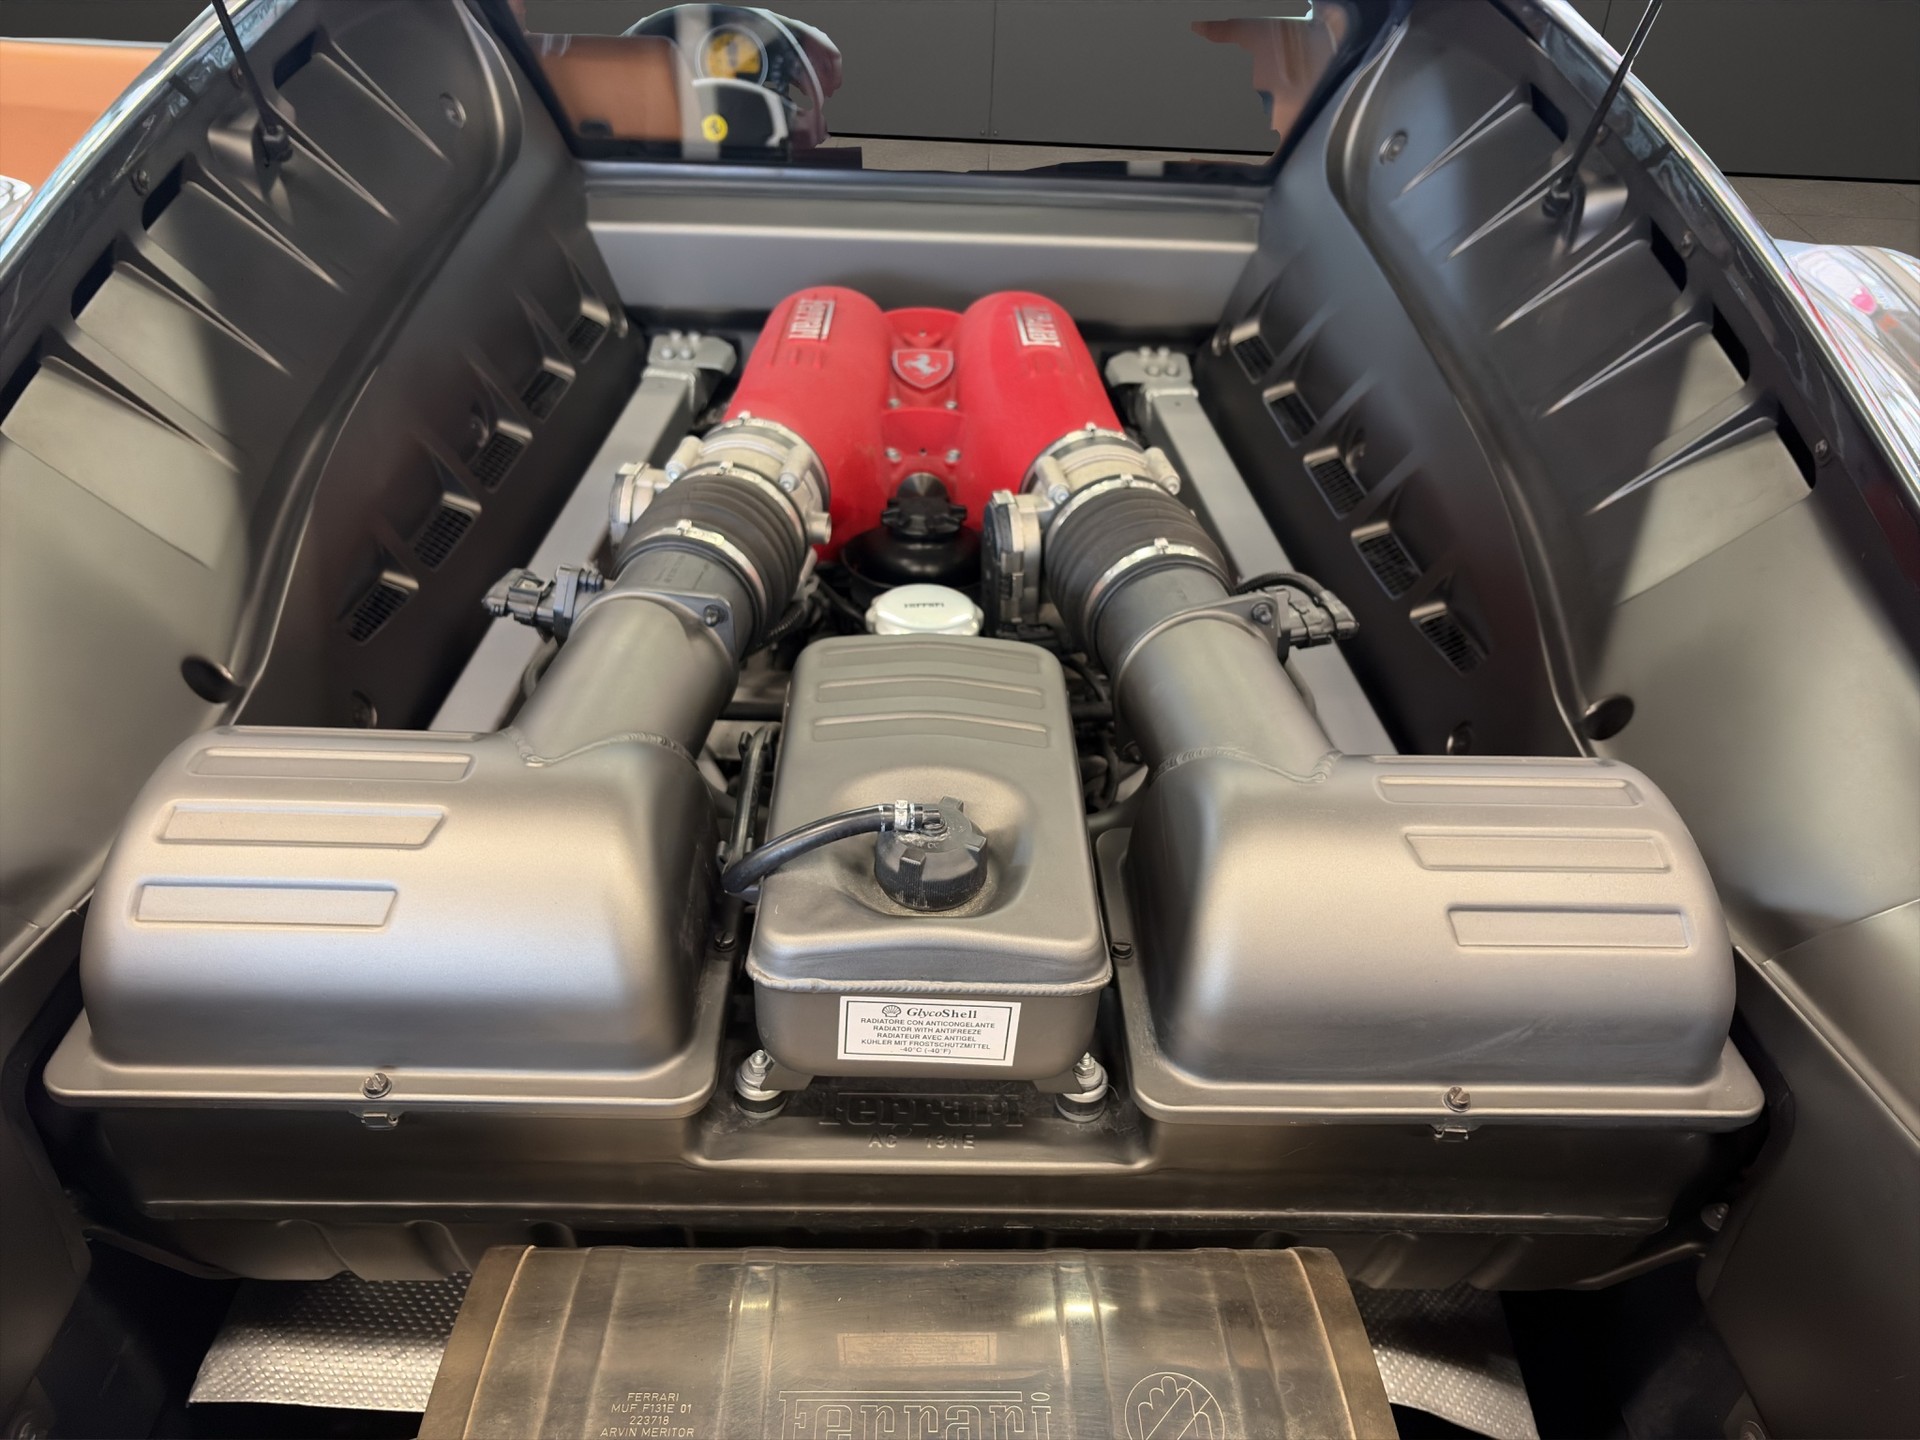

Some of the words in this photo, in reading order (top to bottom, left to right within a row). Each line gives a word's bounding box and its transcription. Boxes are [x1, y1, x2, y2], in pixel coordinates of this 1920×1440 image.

[906, 1007, 978, 1019] GlycoShell
[860, 1017, 905, 1025] RADIATORE
[925, 1020, 996, 1029] ANTICONGELANTE
[876, 1032, 921, 1040] RADIATEUR
[935, 1027, 982, 1035] ANTIFREEZE
[909, 1041, 991, 1050] FROSTSCHUTZMITTEL
[924, 1132, 975, 1150] 131E
[627, 1392, 680, 1402] FERRARI
[611, 1403, 638, 1413] MUF
[642, 1403, 675, 1414] F131E
[680, 1403, 692, 1414] 01
[629, 1415, 670, 1425] 223718
[778, 1390, 1052, 1440] Ferrari
[600, 1427, 638, 1437] ARVIN
[641, 1427, 695, 1438] MERITOR
